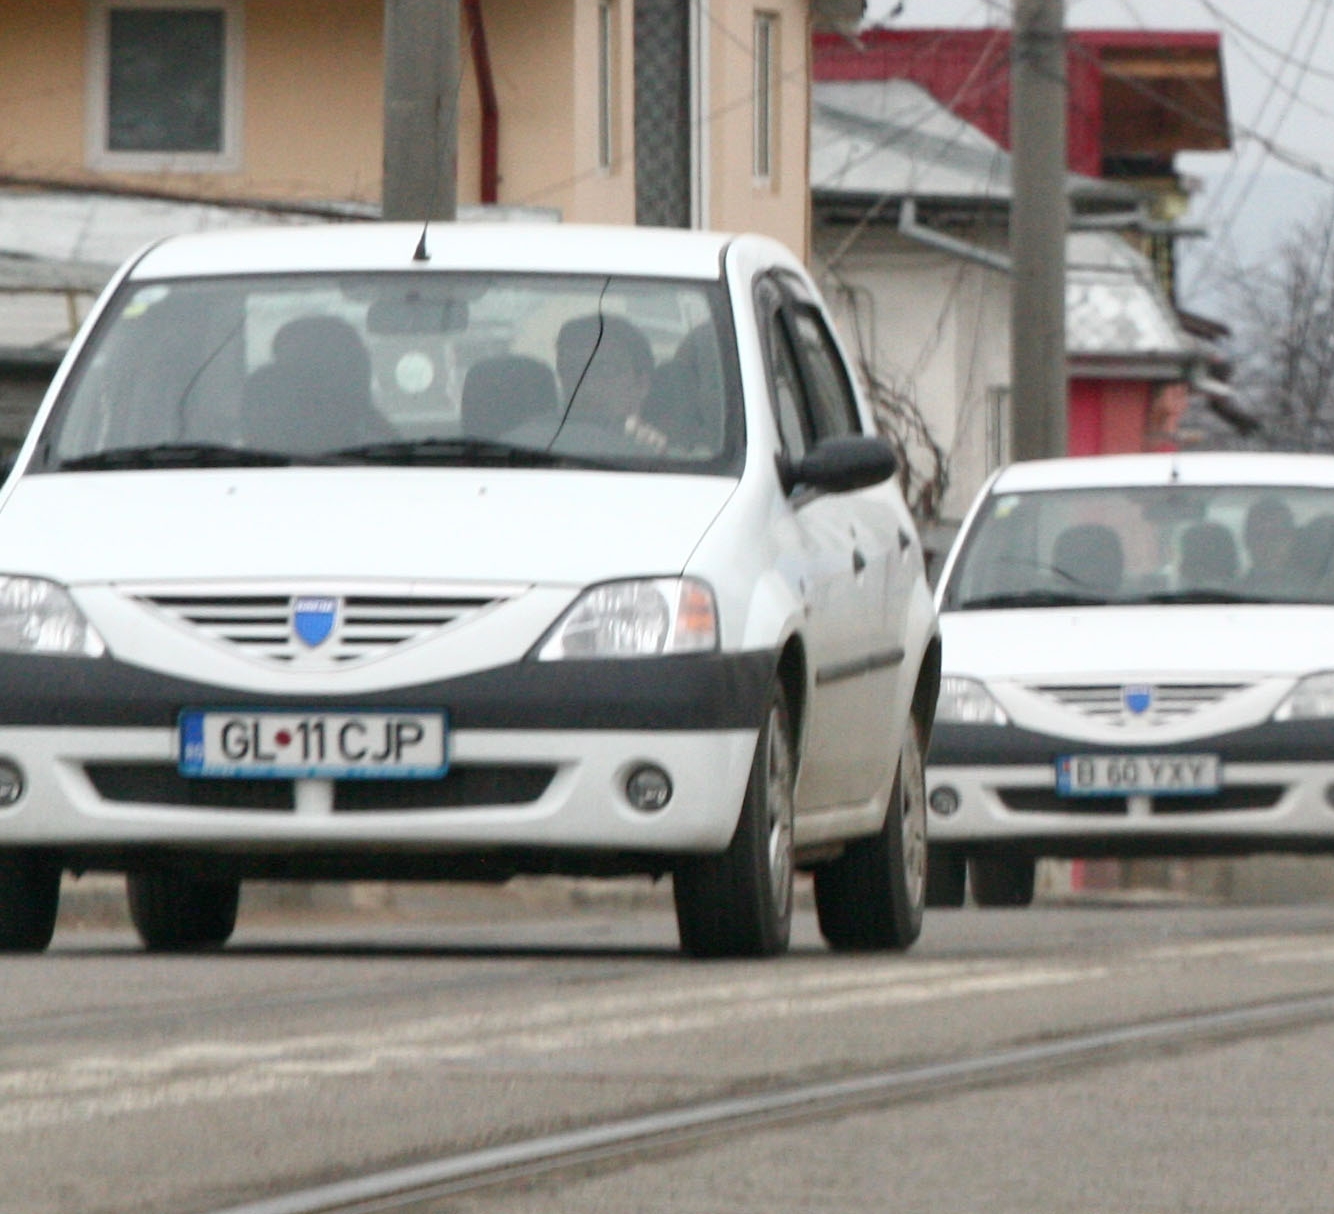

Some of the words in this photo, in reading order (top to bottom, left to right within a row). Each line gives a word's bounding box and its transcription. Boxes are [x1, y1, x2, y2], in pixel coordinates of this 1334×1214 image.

[220, 720, 276, 762] GL
[296, 720, 326, 762] 11
[338, 720, 425, 764] CJP
[1077, 759, 1095, 787] B
[1148, 758, 1202, 788] YXY
